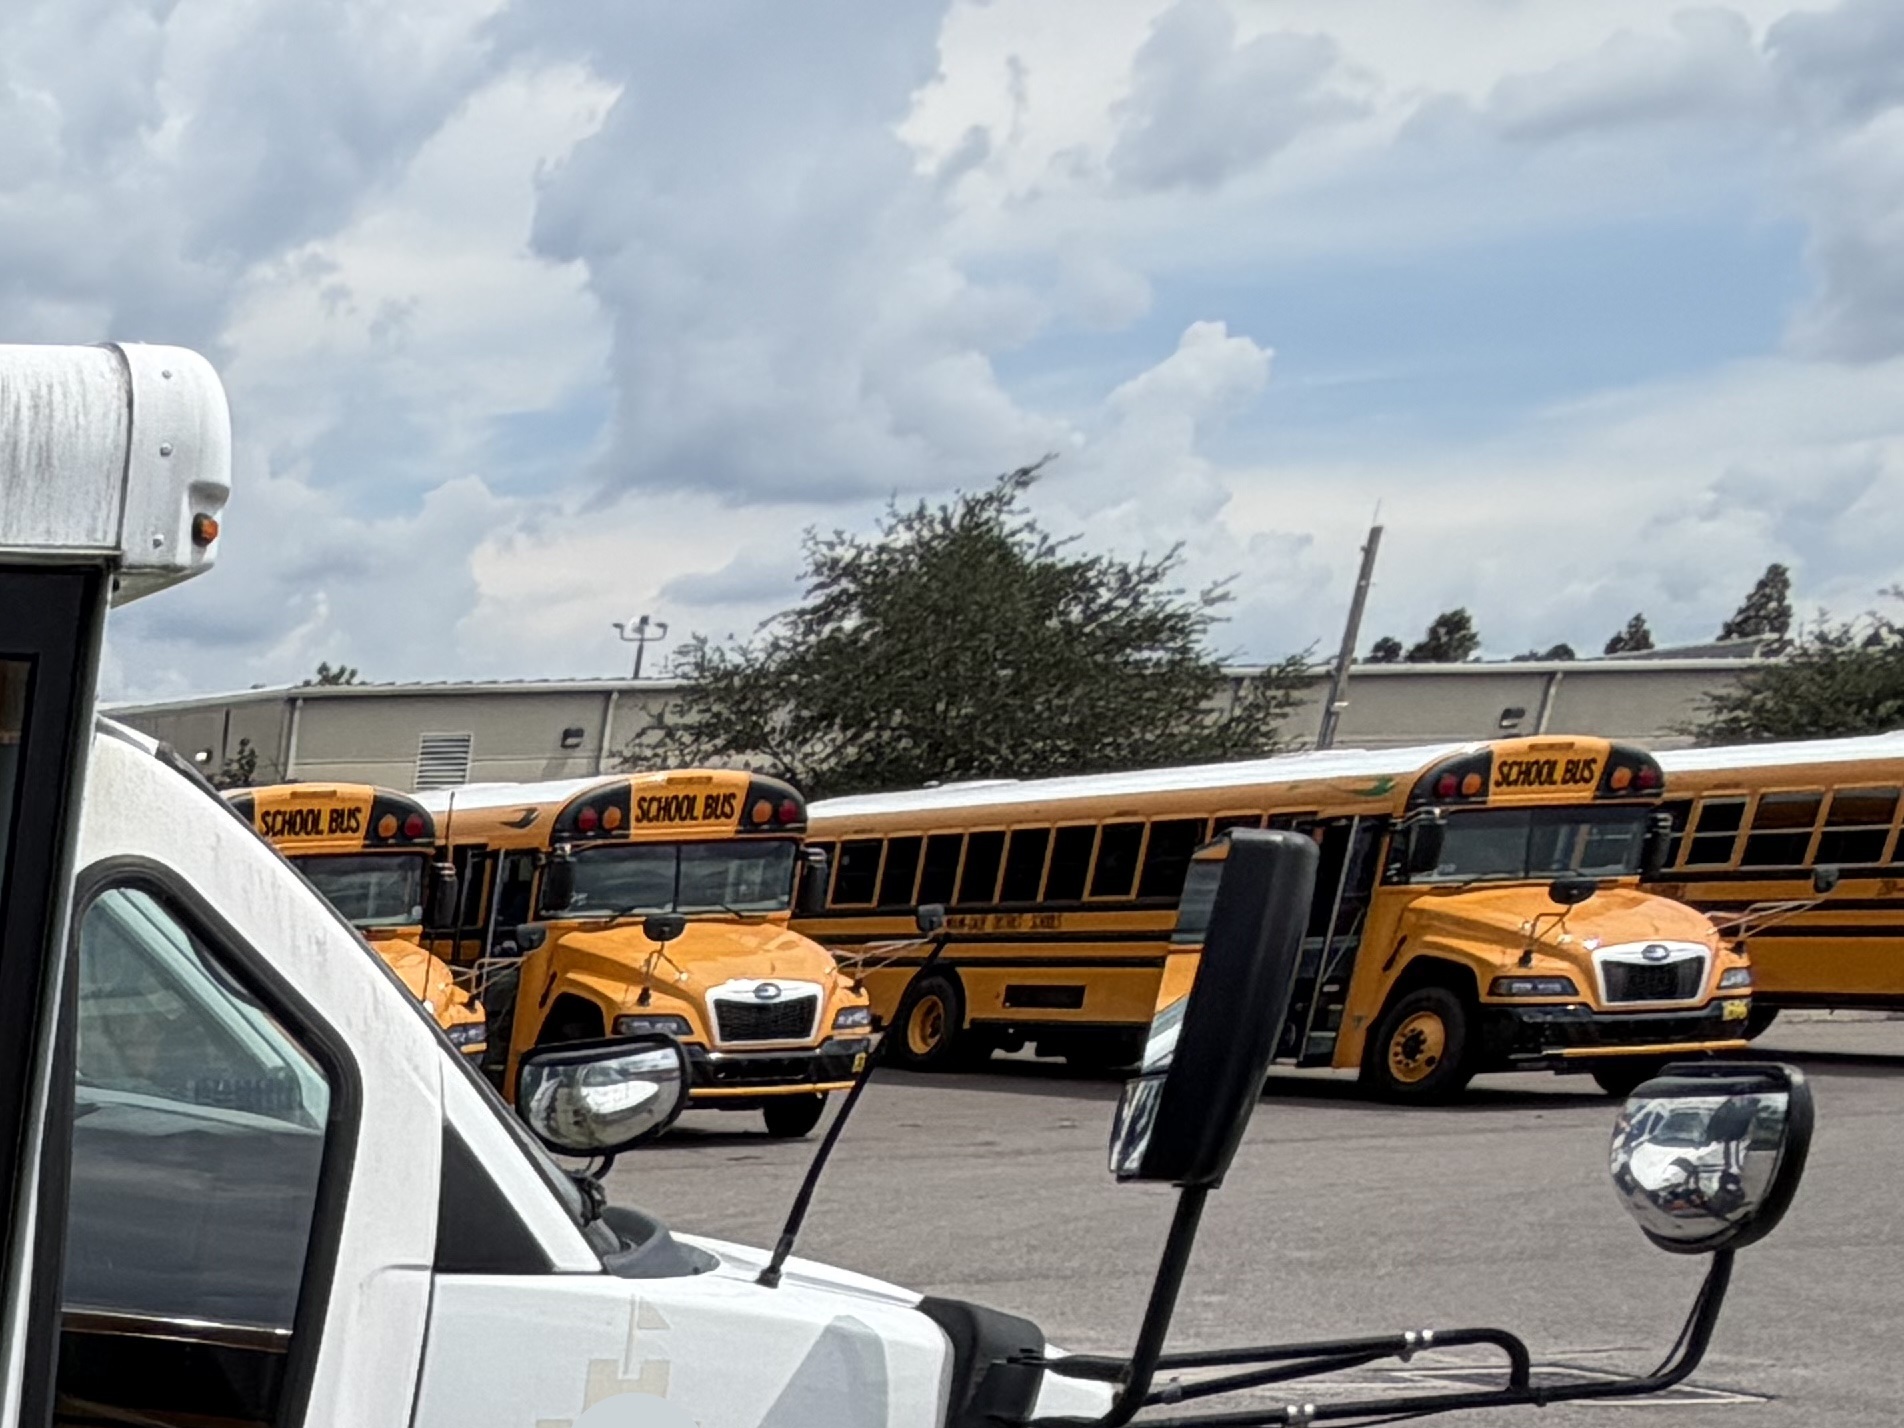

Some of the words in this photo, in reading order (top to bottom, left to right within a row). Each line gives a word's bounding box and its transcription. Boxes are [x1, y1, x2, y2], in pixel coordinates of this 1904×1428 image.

[1494, 758, 1558, 788] SCHOOL
[1561, 757, 1598, 785] BUS
[260, 808, 324, 836] SCHOOL
[328, 806, 362, 833] BUS
[635, 794, 699, 823] SCHOOL
[702, 792, 737, 820] BUS
